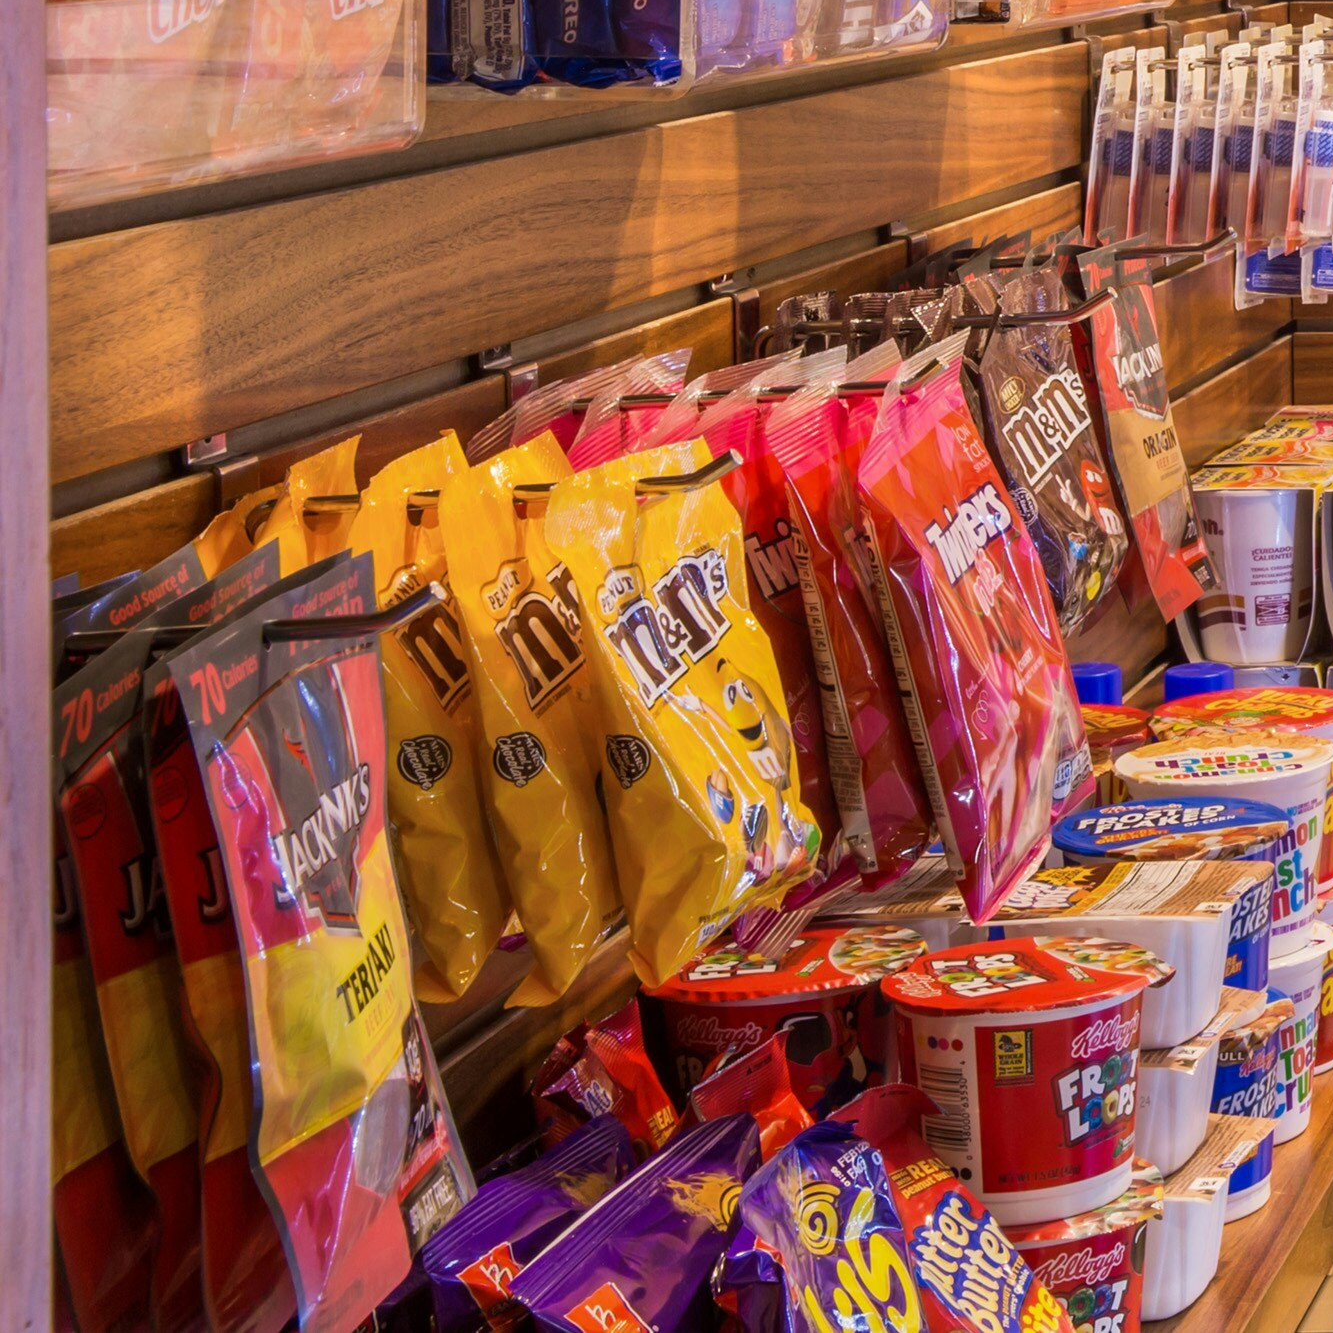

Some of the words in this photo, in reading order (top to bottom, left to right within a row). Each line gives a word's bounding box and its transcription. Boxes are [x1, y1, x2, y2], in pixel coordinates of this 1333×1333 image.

[1003, 369, 1092, 484] m&m's
[962, 440, 986, 464] fat
[109, 598, 142, 626] Good
[139, 579, 172, 607] Source
[172, 563, 191, 590] of
[189, 595, 218, 622] Good
[217, 570, 252, 604] Source
[292, 594, 316, 619] Good
[314, 581, 348, 608] Source
[347, 572, 360, 590] of
[487, 569, 521, 611] PEANUT
[600, 576, 635, 614] PENUT
[605, 550, 731, 706] m&m's
[59, 686, 94, 759] 70
[96, 665, 142, 713] Calories
[189, 661, 227, 726] 70
[221, 654, 259, 691] Calories
[401, 739, 433, 791] Chocolate
[496, 737, 528, 787] Chocolate
[515, 747, 530, 765] Real
[1076, 803, 1227, 831] FROSTED
[1092, 811, 1219, 836] FLAKES
[1195, 814, 1237, 826] CORN
[677, 1015, 763, 1052] Kellogg's
[1219, 1051, 1244, 1061] ULL
[1057, 1050, 1139, 1111] FROOT
[1067, 1081, 1137, 1141] LOOPS
[900, 1175, 932, 1200] peanut
[1034, 1243, 1126, 1290] Kellogg's
